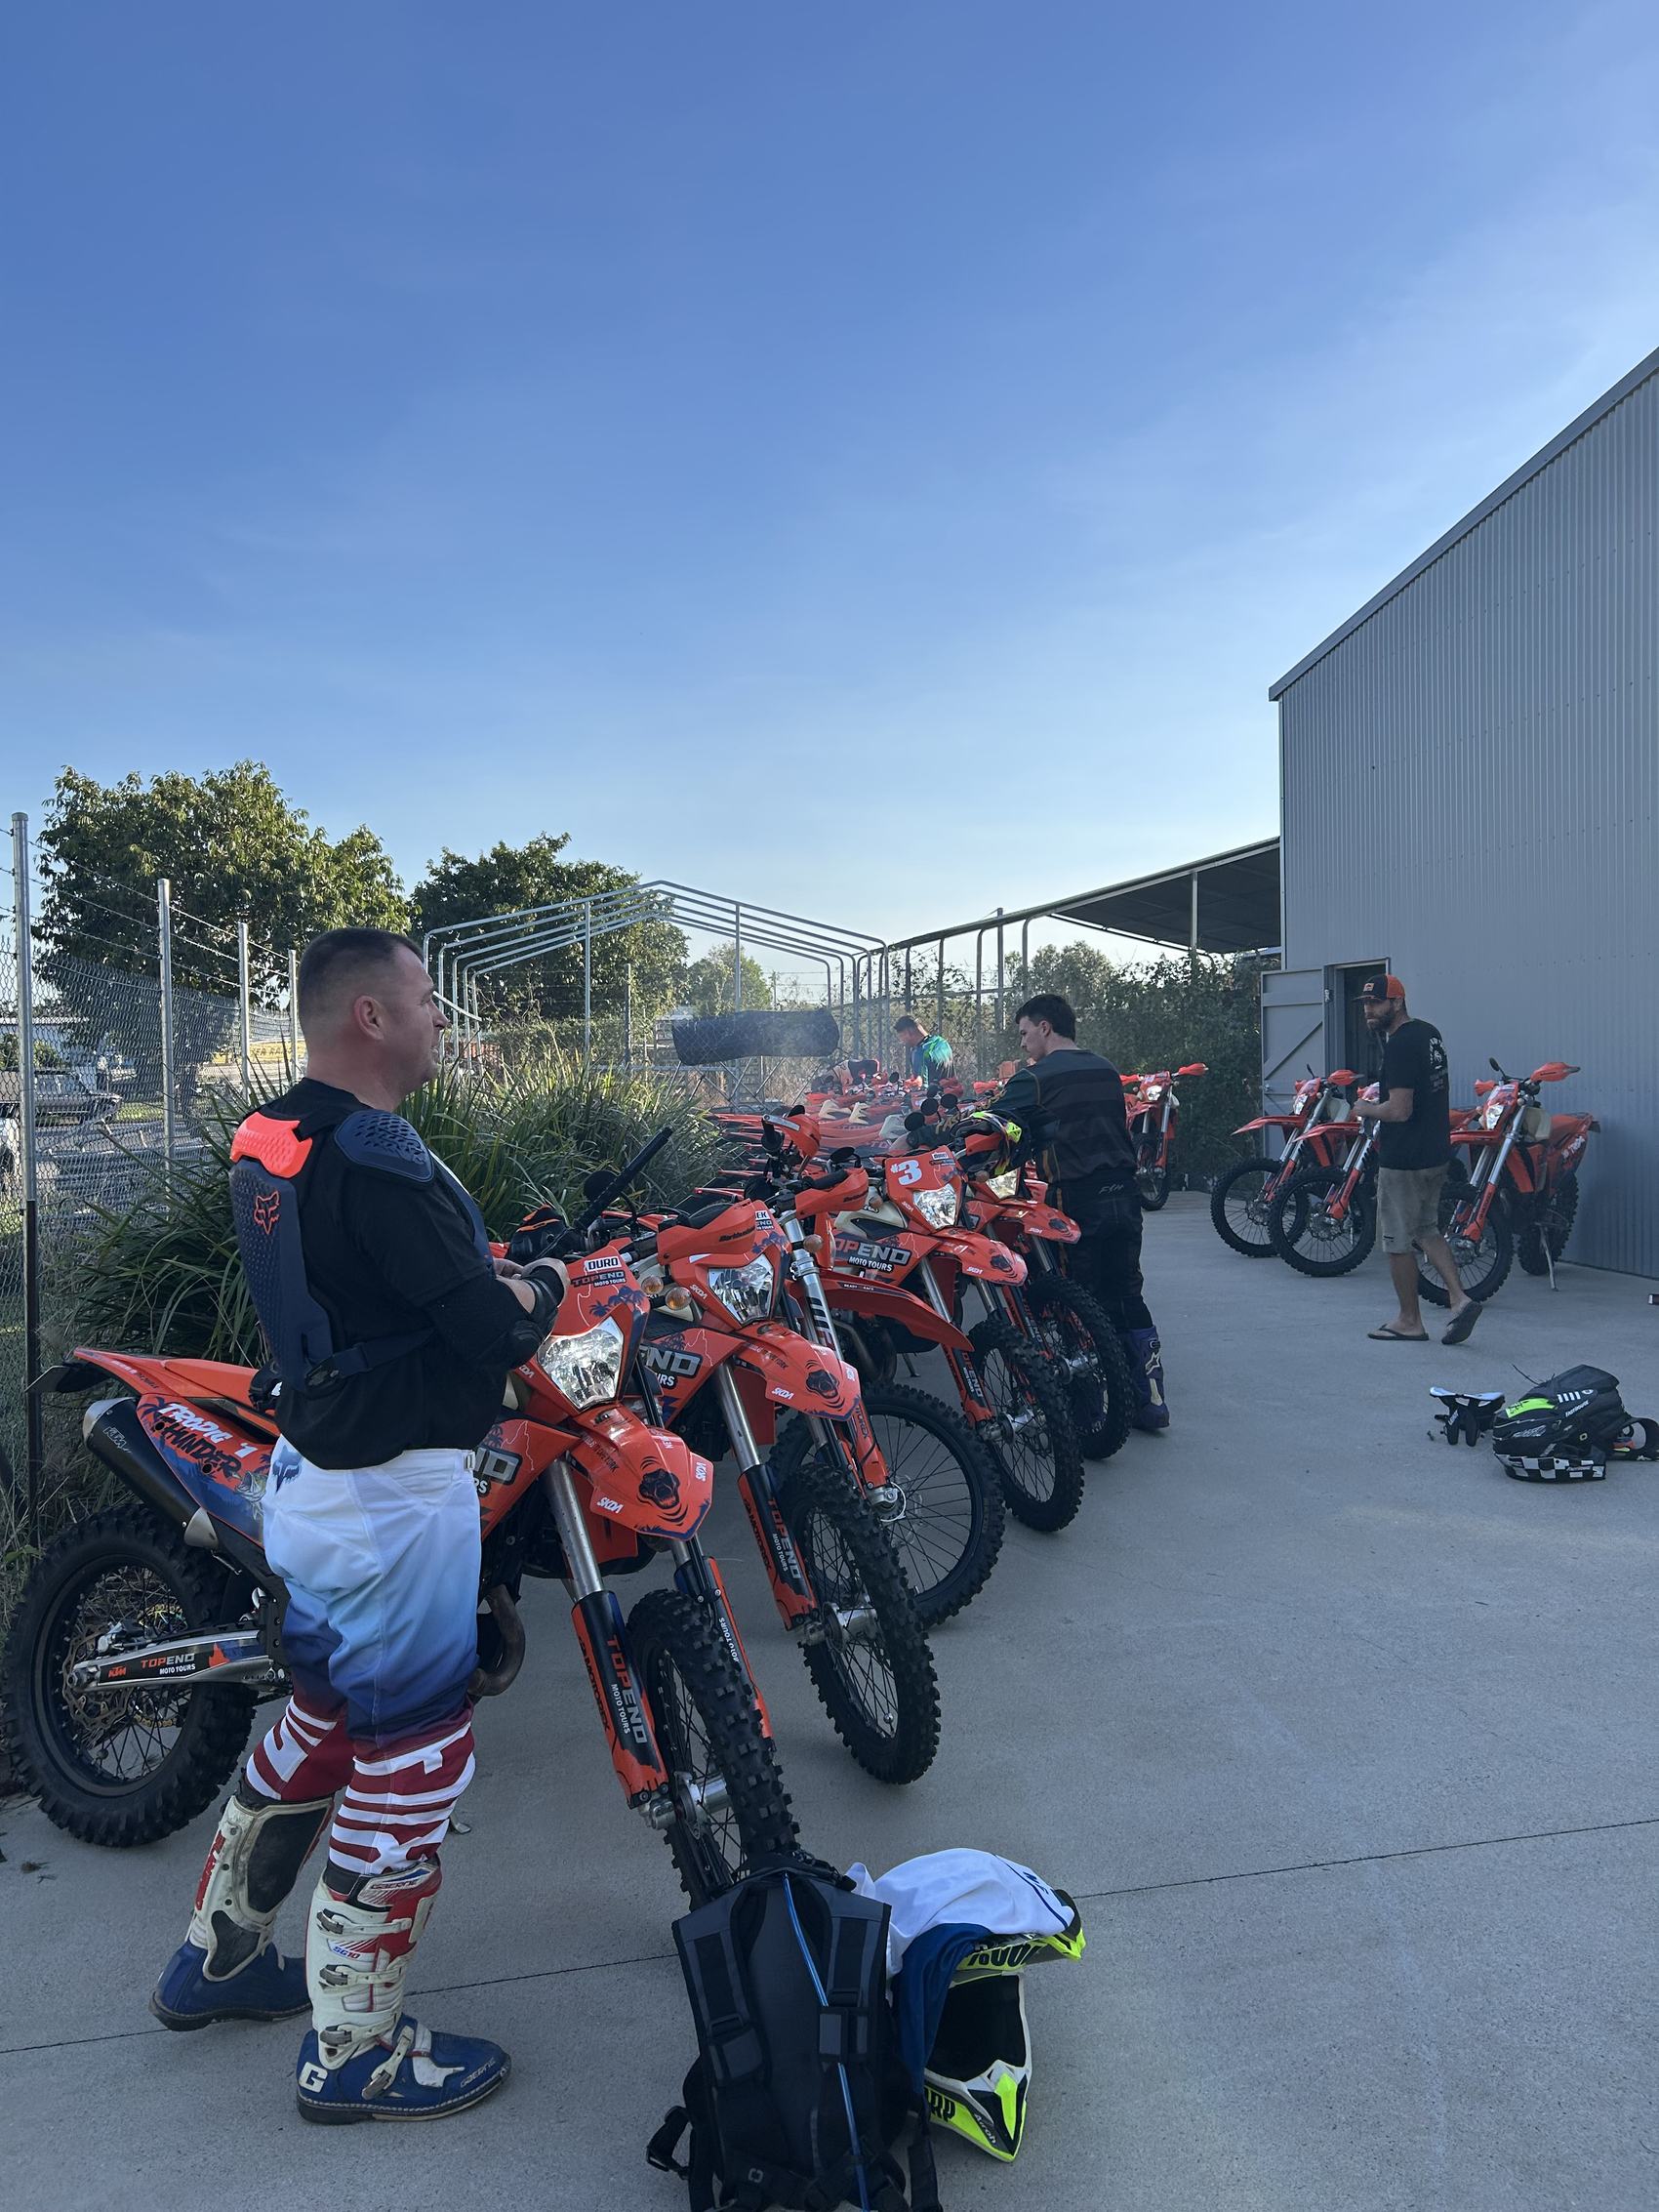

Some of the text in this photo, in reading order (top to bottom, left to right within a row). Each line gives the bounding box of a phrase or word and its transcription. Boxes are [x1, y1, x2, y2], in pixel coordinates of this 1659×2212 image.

[890, 1160, 922, 1185] #3
[587, 1257, 619, 1270] DURO
[848, 1256, 893, 1272] MOTO TOURS
[572, 1271, 625, 1286] TOPEND
[102, 1426, 127, 1449] KTM
[596, 1497, 624, 1514] SKDA
[768, 1497, 801, 1578] TOPEND
[772, 1533, 789, 1572] MOTO TOURS
[718, 1617, 732, 1643] TOURS
[108, 1665, 127, 1677] KTM
[141, 1653, 195, 1668] TOPEND
[159, 1663, 196, 1675] MOTO TOURS
[607, 1634, 648, 1743] TOPEND
[610, 1683, 631, 1734] MOTO TOURS
[333, 1946, 361, 1960] SG10
[299, 2061, 329, 2093] G
[460, 2056, 497, 2088] GAERNE
[974, 2111, 996, 2145] Airoh
